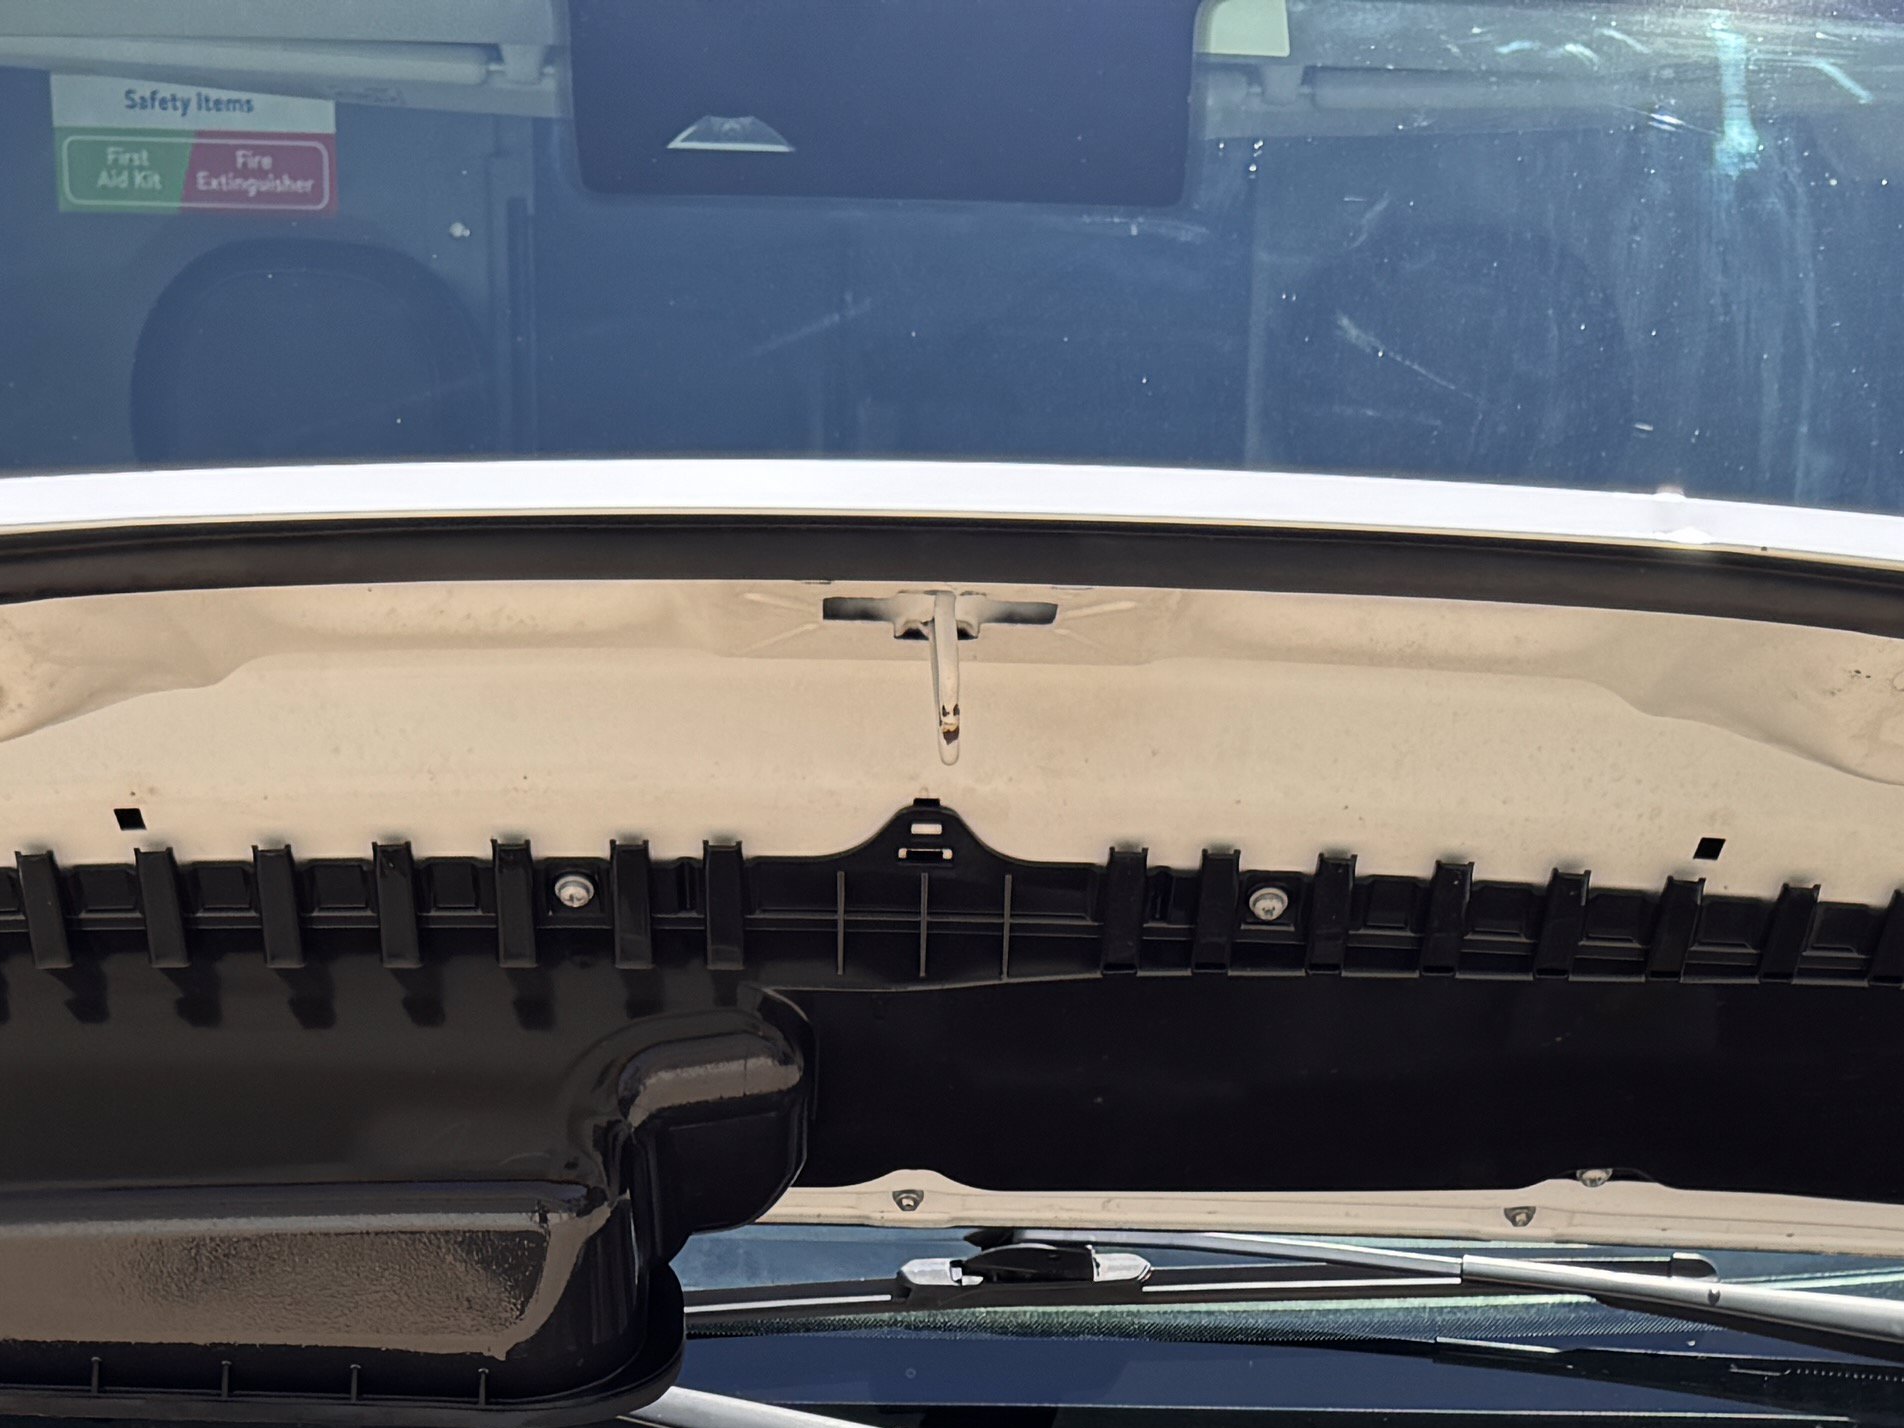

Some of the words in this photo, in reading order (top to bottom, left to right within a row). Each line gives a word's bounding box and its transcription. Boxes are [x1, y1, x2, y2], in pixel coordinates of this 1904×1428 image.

[124, 88, 192, 117] Safety
[196, 92, 255, 113] Items
[106, 146, 150, 166] First
[234, 149, 273, 170] Fire
[97, 169, 129, 188] Aid
[134, 170, 162, 190] Kit
[196, 171, 315, 197] Extinguisher
